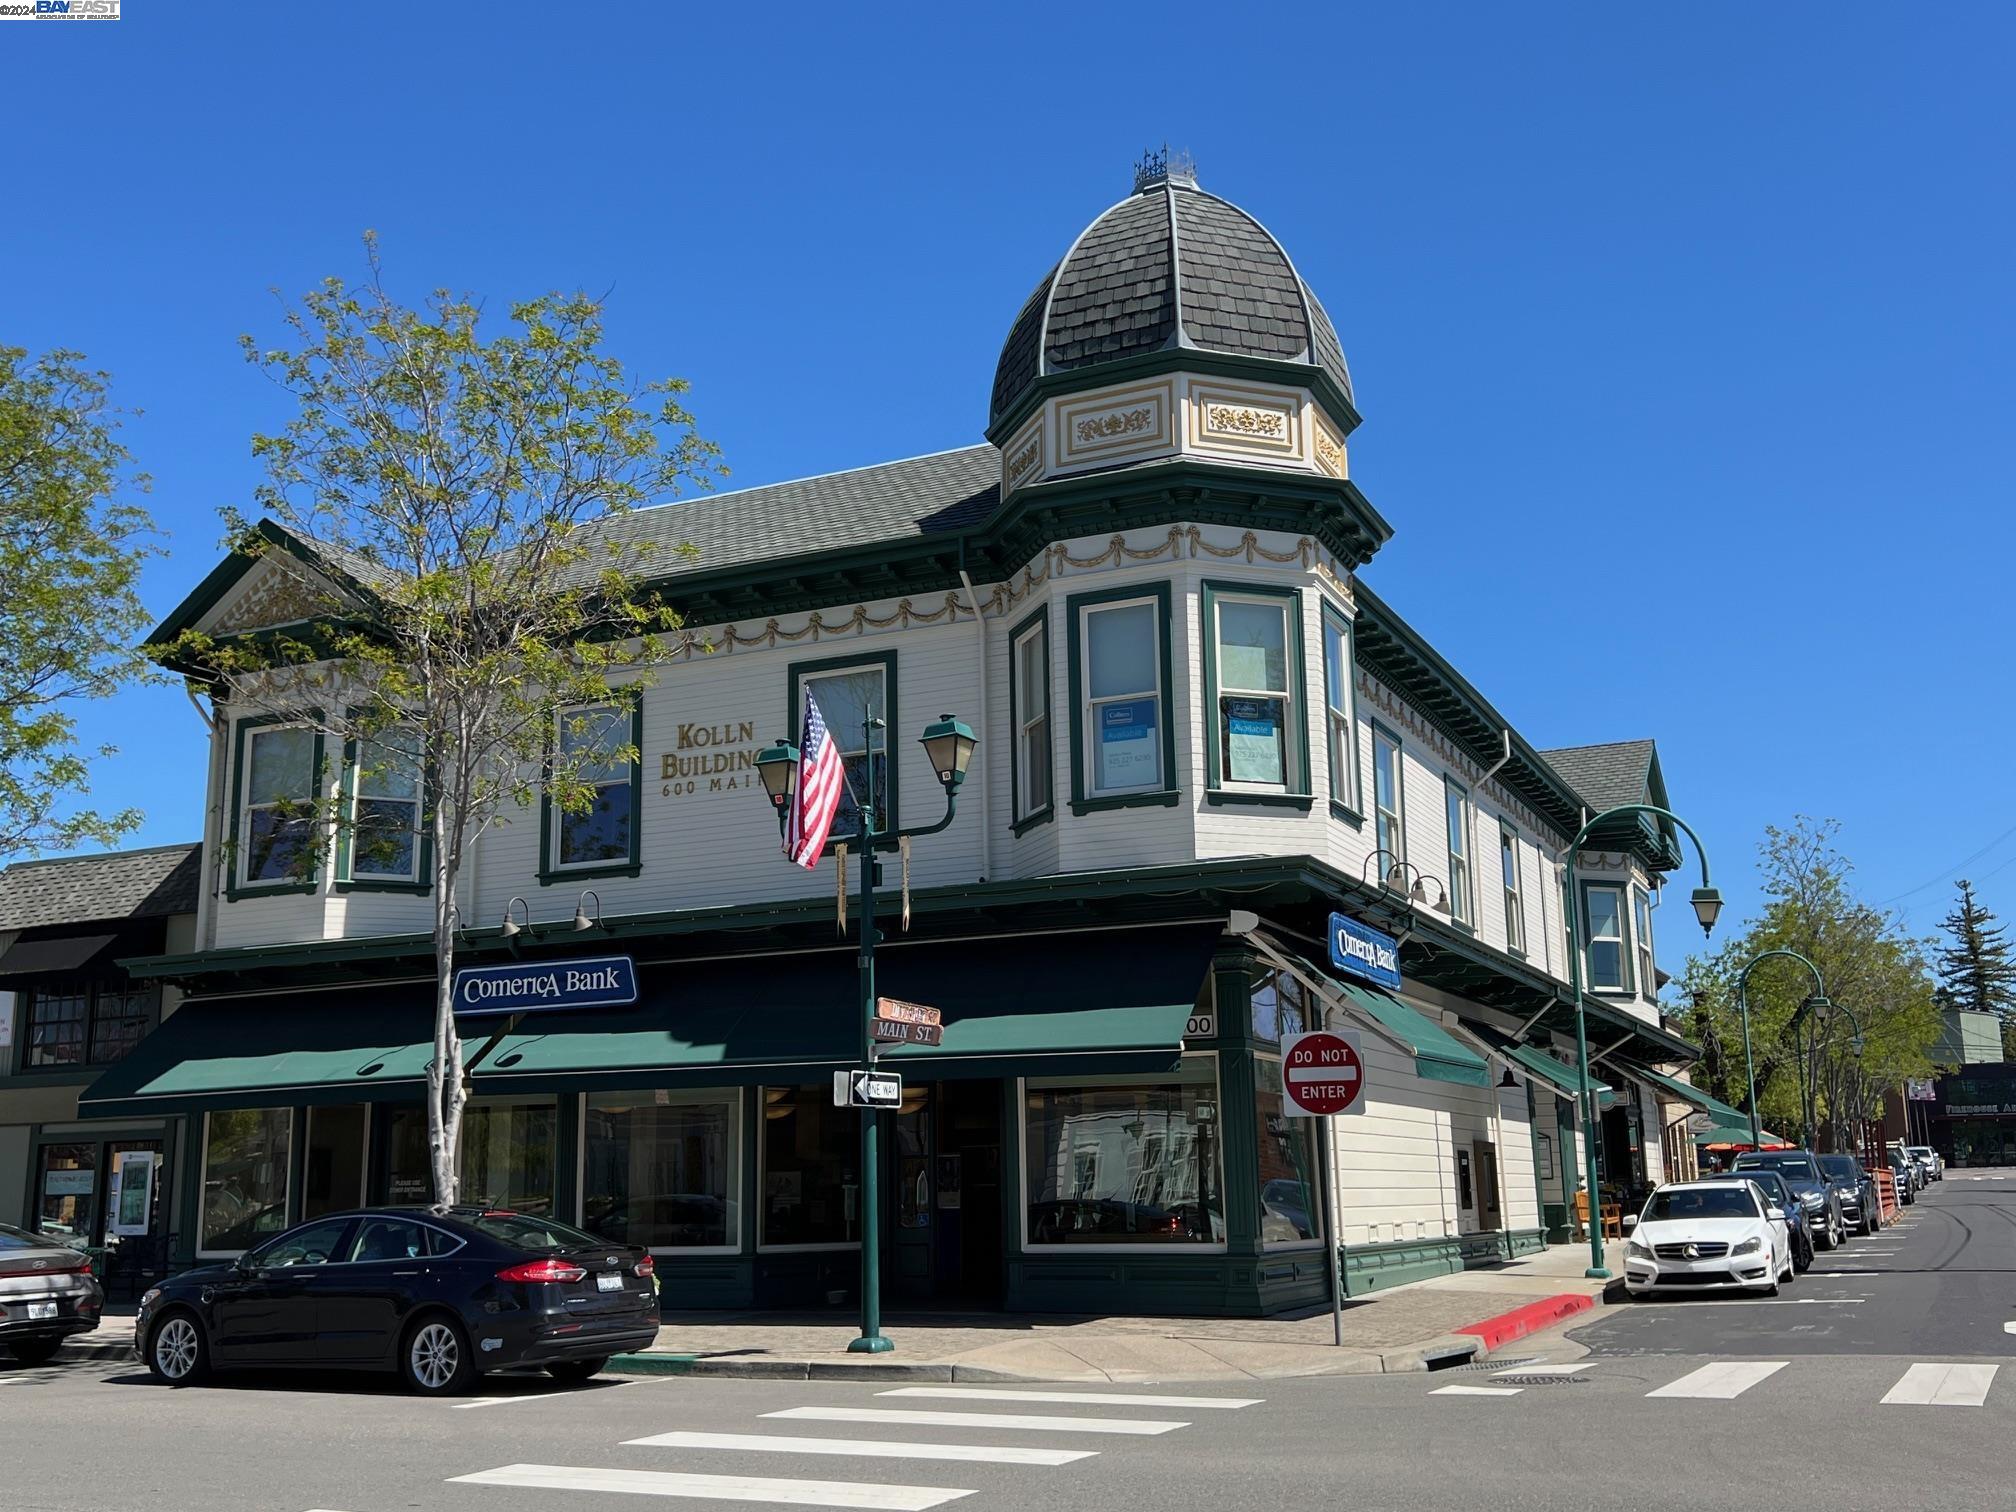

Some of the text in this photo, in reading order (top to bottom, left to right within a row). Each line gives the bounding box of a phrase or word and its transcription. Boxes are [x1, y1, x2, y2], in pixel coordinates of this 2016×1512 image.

[677, 721, 753, 750] KOLLN
[1234, 723, 1268, 734] Available
[662, 781, 695, 797] 600
[1376, 944, 1396, 972] Bank
[566, 967, 620, 992] Bank
[877, 1022, 909, 1038] MAIN
[1294, 1049, 1349, 1063] DO NOT
[867, 1083, 896, 1096] ONE WAY
[1301, 1085, 1346, 1099] ENTER
